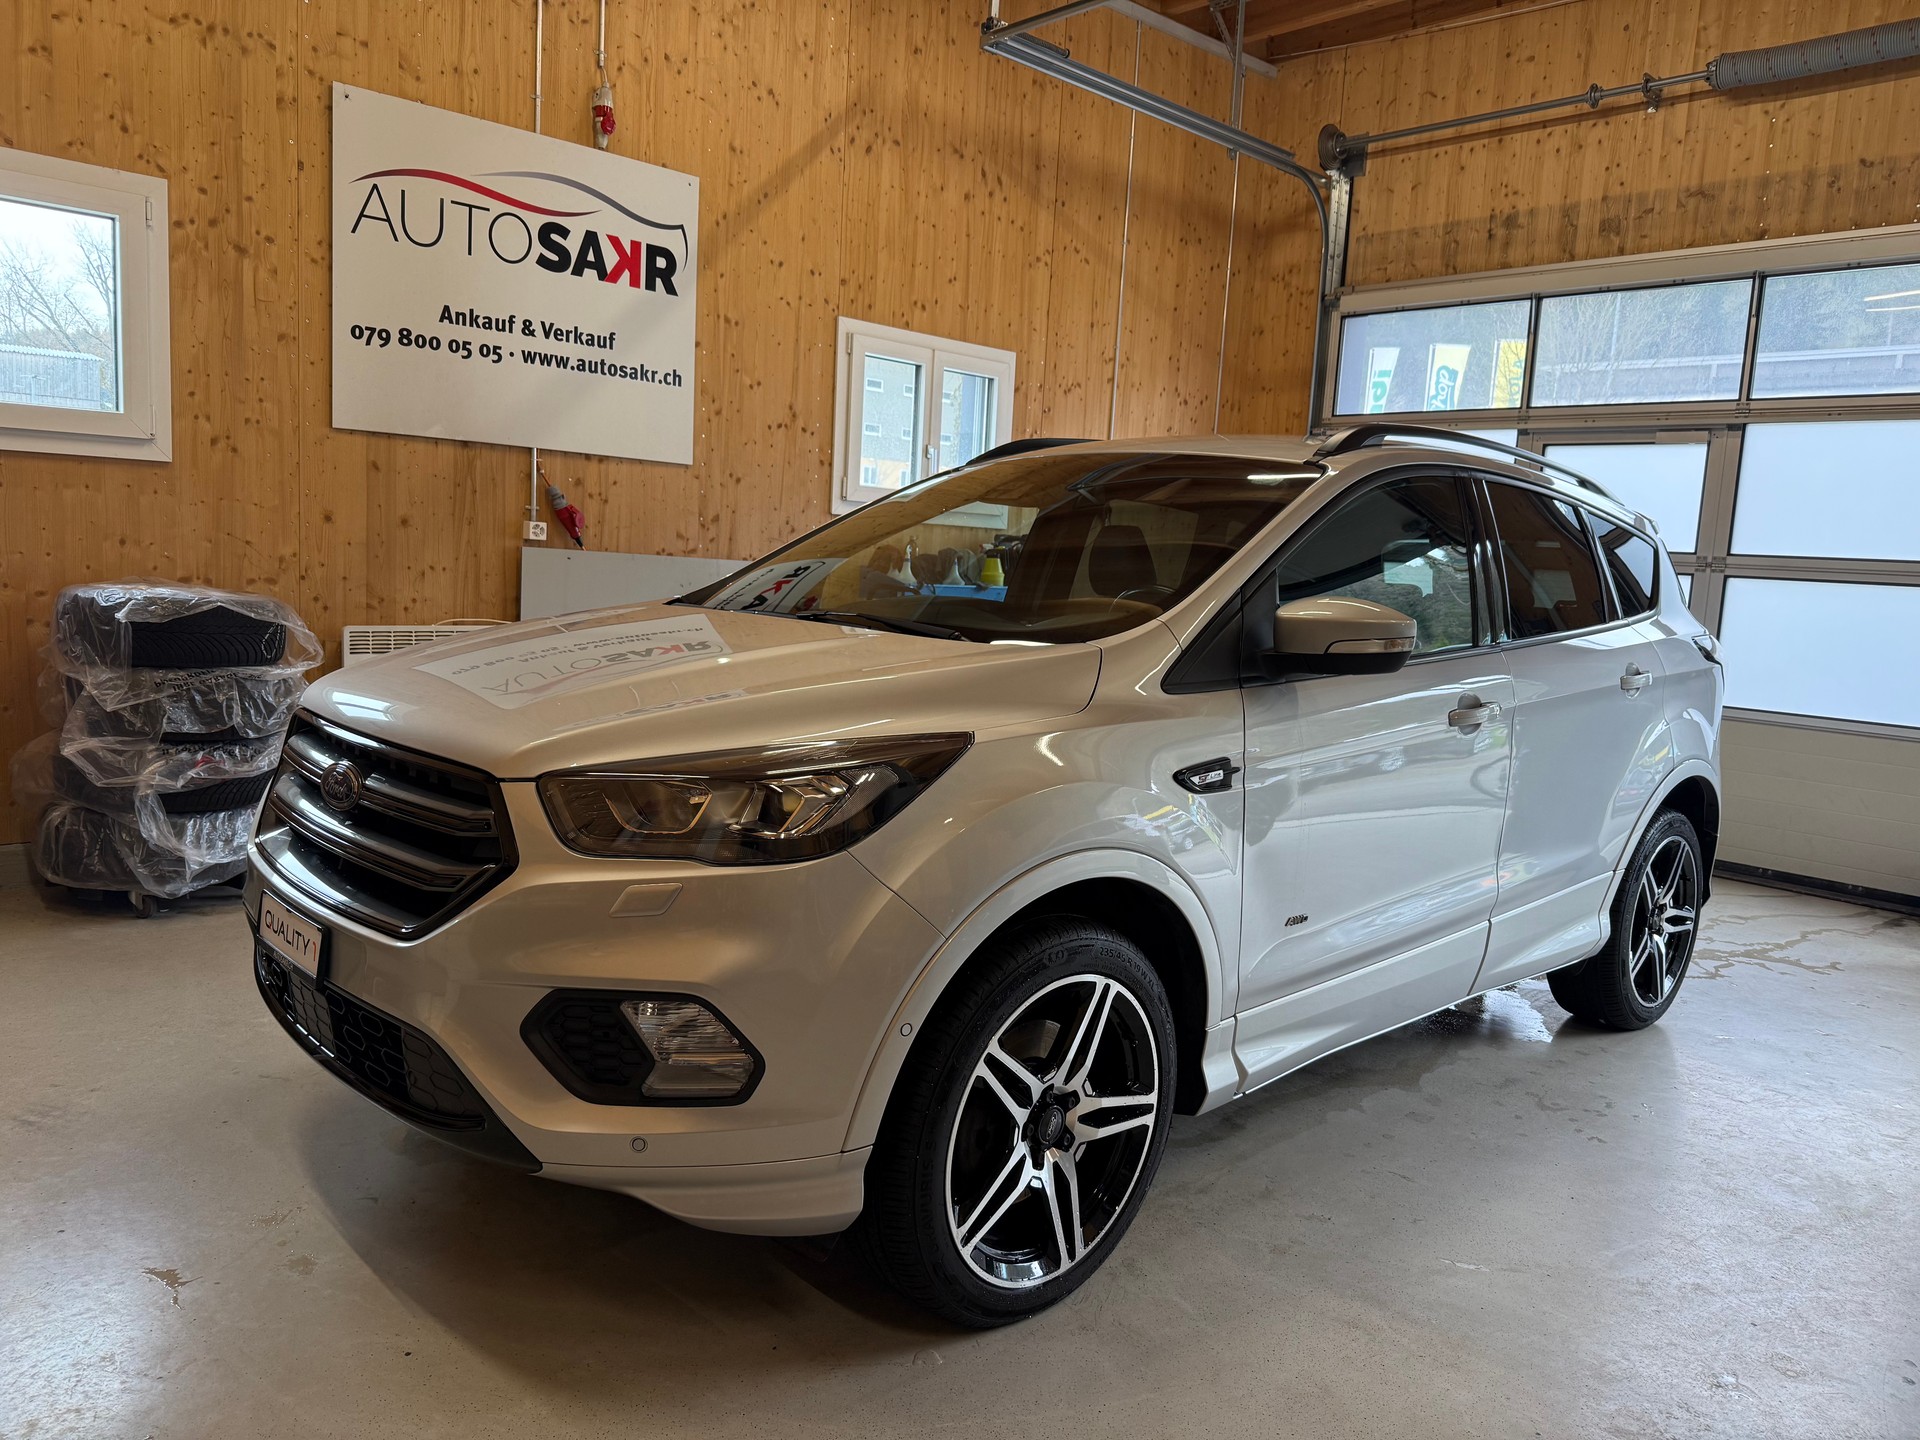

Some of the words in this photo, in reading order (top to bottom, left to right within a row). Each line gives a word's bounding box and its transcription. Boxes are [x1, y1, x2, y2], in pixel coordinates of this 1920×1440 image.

[350, 182, 679, 297] AUTOSAKR
[350, 324, 392, 348] 079
[398, 327, 442, 351] 800
[447, 338, 473, 360] 05
[478, 343, 503, 364] 05
[521, 349, 682, 387] www.autosakr.ch
[438, 304, 516, 334] Ankauf
[521, 319, 537, 338] &
[540, 321, 616, 350] Verkauf
[264, 909, 311, 956] QUALITY
[312, 940, 317, 962] 1
